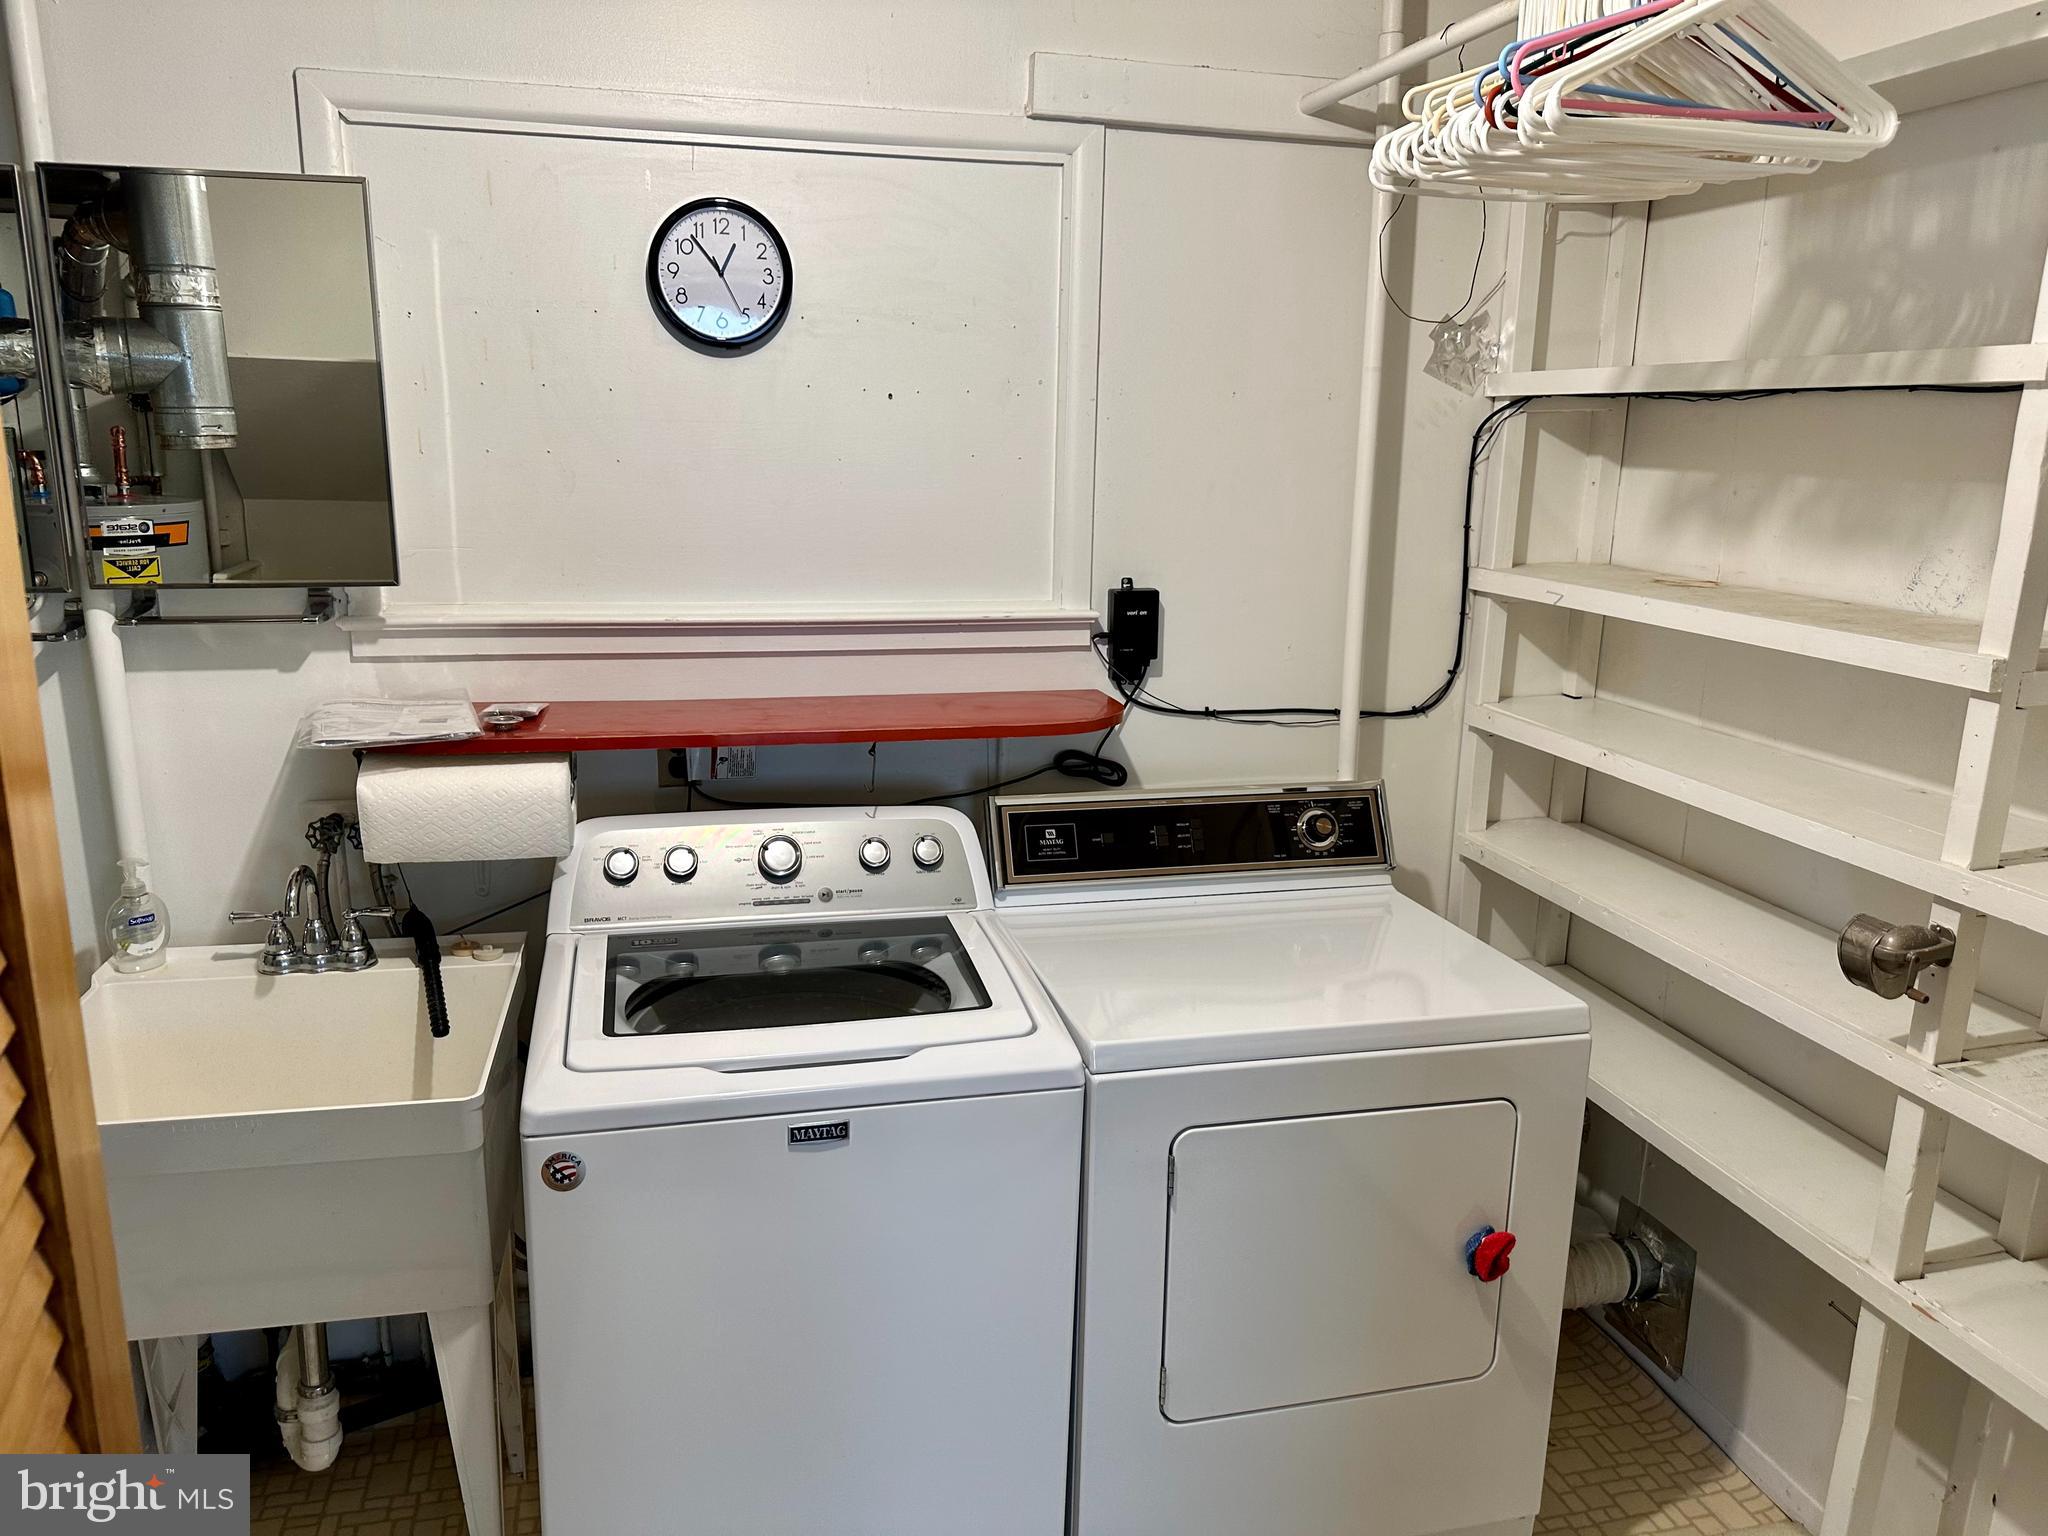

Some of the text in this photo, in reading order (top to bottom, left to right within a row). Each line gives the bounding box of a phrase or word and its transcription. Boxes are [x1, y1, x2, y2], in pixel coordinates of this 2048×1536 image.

[693, 221, 705, 239] 11
[712, 217, 730, 235] 12
[740, 224, 747, 241] 1
[674, 237, 694, 255] 10
[756, 242, 767, 260] 2
[667, 261, 680, 279] 9
[762, 267, 774, 285] 3
[675, 287, 688, 304] 8
[756, 292, 767, 309] 4
[697, 305, 706, 323] 7
[715, 311, 729, 329] 6
[740, 307, 751, 325] 5
[792, 1125, 847, 1142] MAYTAG
[544, 1152, 582, 1170] AMERICA
